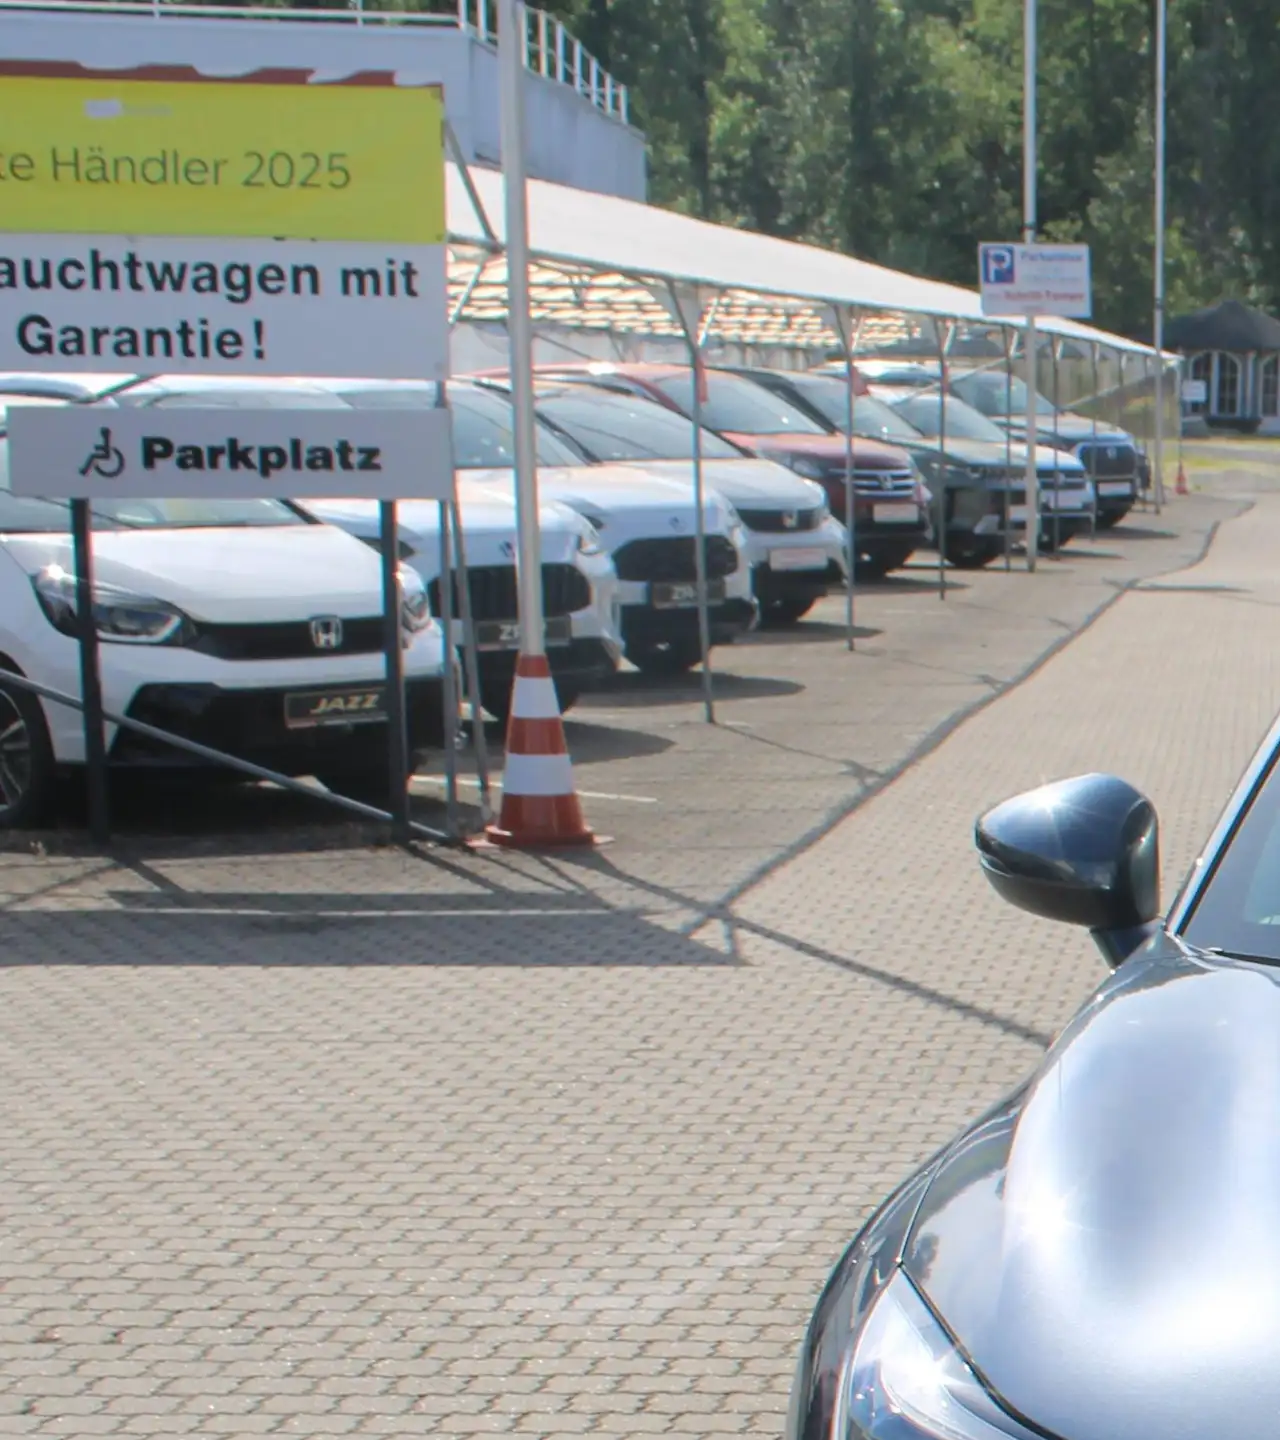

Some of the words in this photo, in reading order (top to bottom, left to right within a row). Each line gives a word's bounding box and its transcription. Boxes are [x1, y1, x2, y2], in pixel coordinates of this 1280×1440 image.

[51, 146, 229, 187] Händler
[242, 150, 352, 190] 2025
[341, 257, 419, 297] mit
[17, 312, 266, 360] Garantie!
[141, 436, 382, 478] Parkplatz
[309, 694, 379, 714] JAZZ
